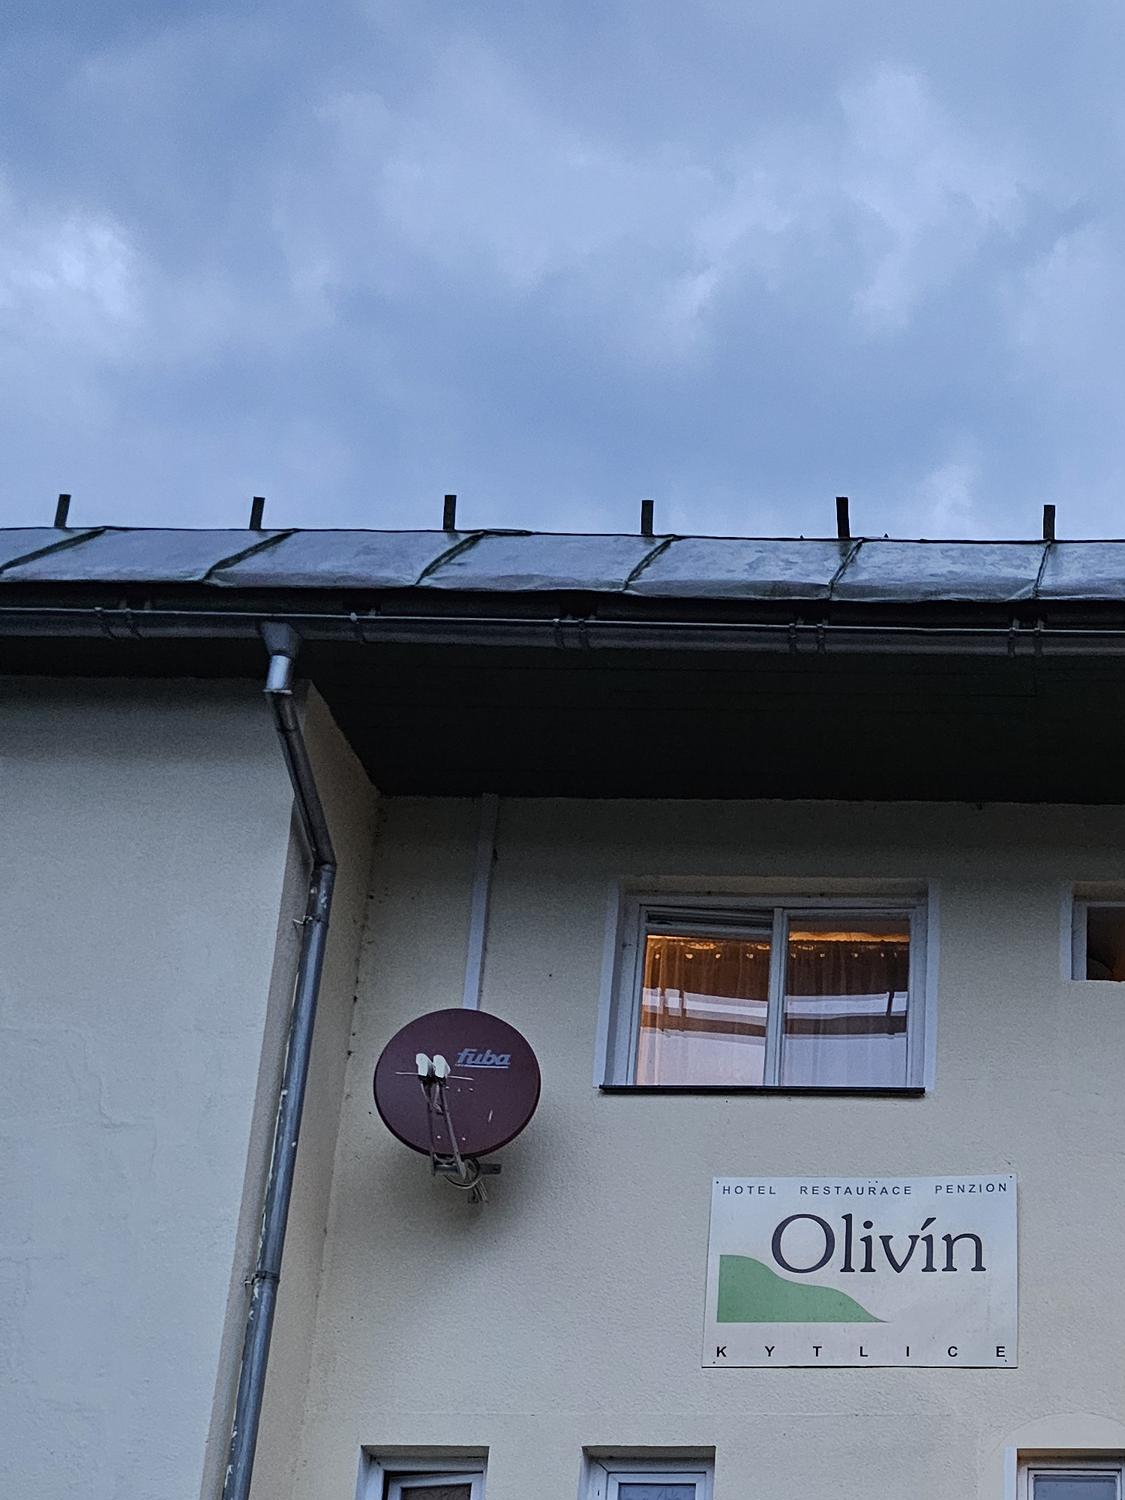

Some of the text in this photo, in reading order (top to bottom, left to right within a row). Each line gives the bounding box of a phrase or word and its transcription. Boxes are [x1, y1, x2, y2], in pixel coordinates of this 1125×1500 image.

[722, 1182, 1008, 1196] HOTEL RESTAURACE PENZION
[771, 1212, 987, 1274] Olivín
[715, 1345, 1006, 1358] KYTLICE
